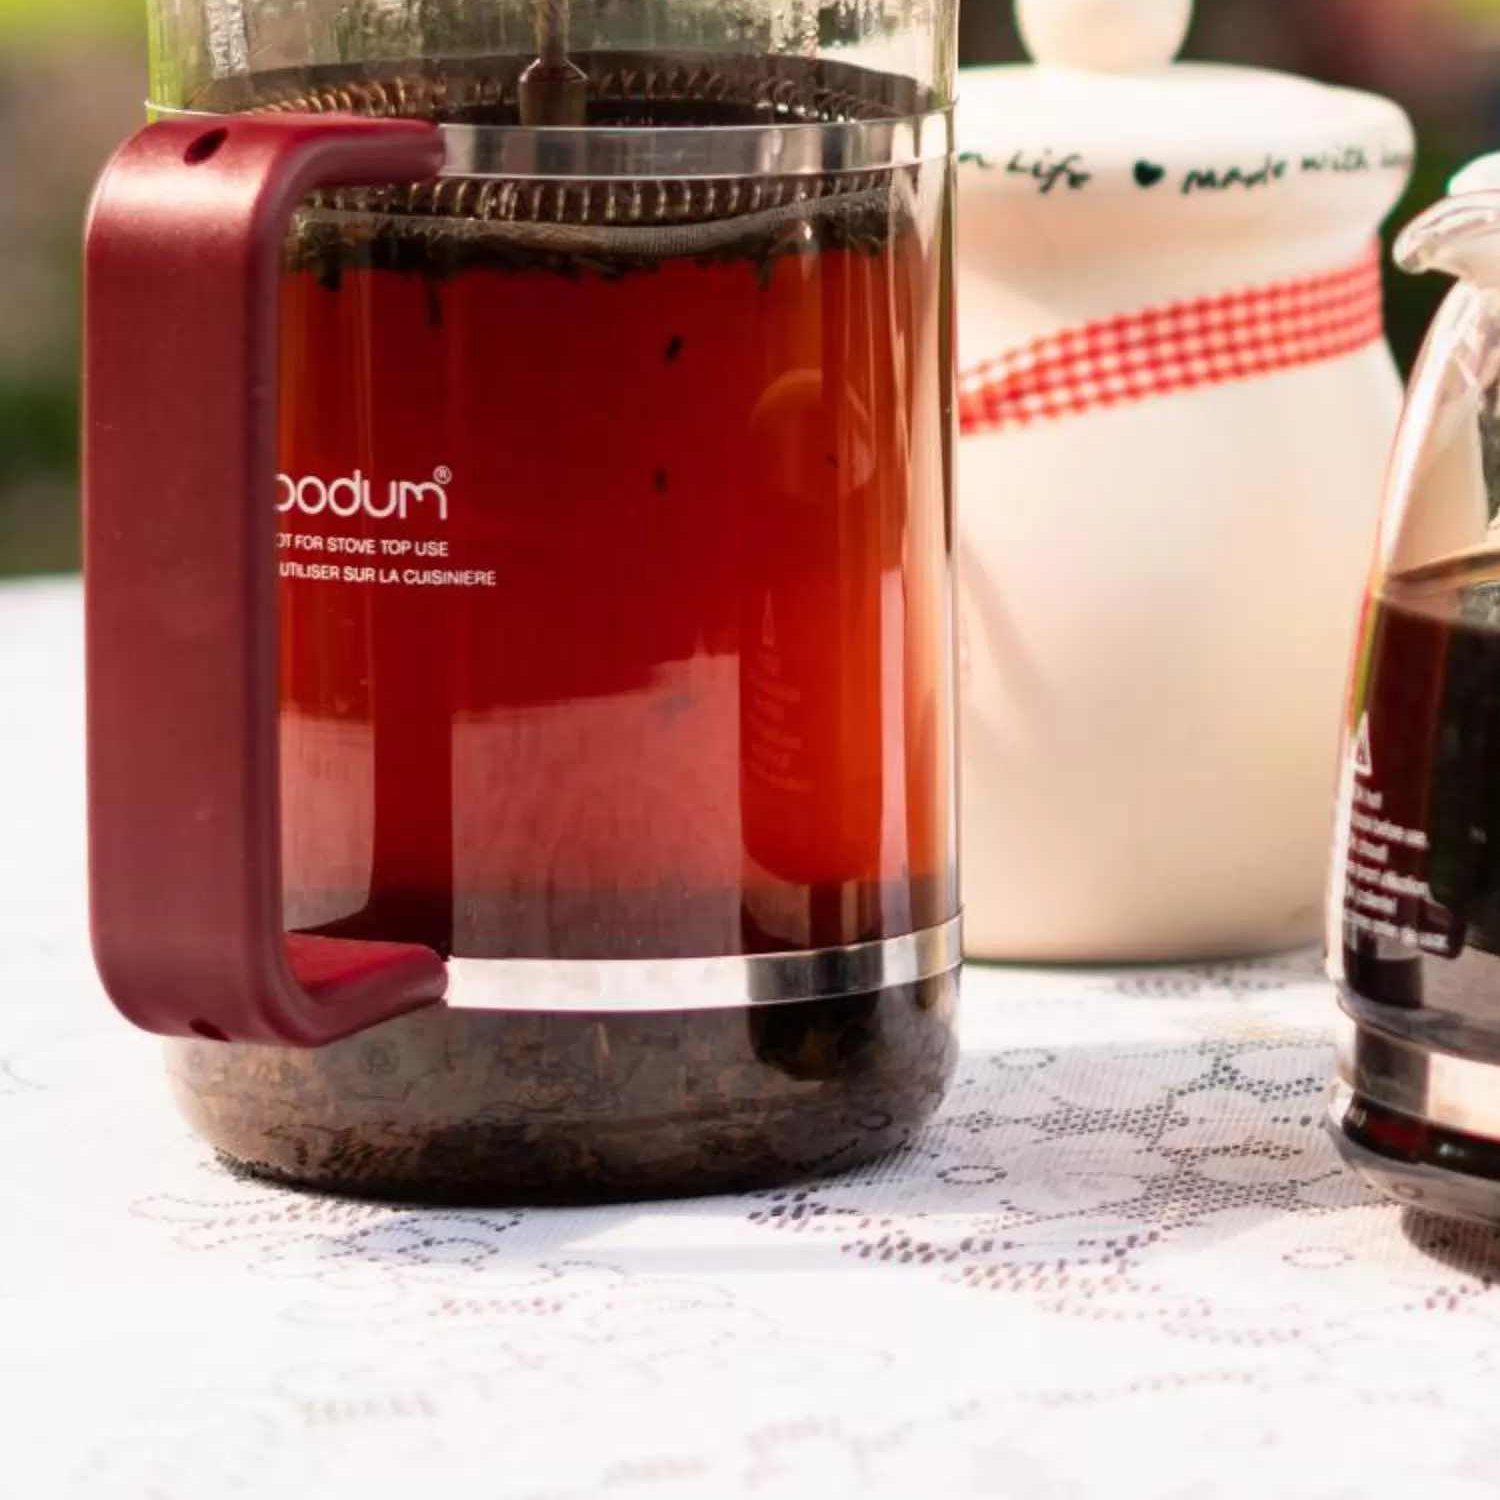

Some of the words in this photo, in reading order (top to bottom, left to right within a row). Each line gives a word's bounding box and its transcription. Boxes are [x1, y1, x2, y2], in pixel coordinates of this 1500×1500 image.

[1181, 153, 1288, 194] made
[1302, 138, 1369, 172] with
[294, 534, 323, 551] FOR
[327, 537, 376, 555] STOVE
[380, 539, 411, 556] TOP
[415, 540, 449, 557] USE
[279, 561, 340, 580] UTILISER
[343, 565, 376, 583] SUR
[379, 568, 400, 584] LA
[403, 569, 496, 587] CUISINIERE
